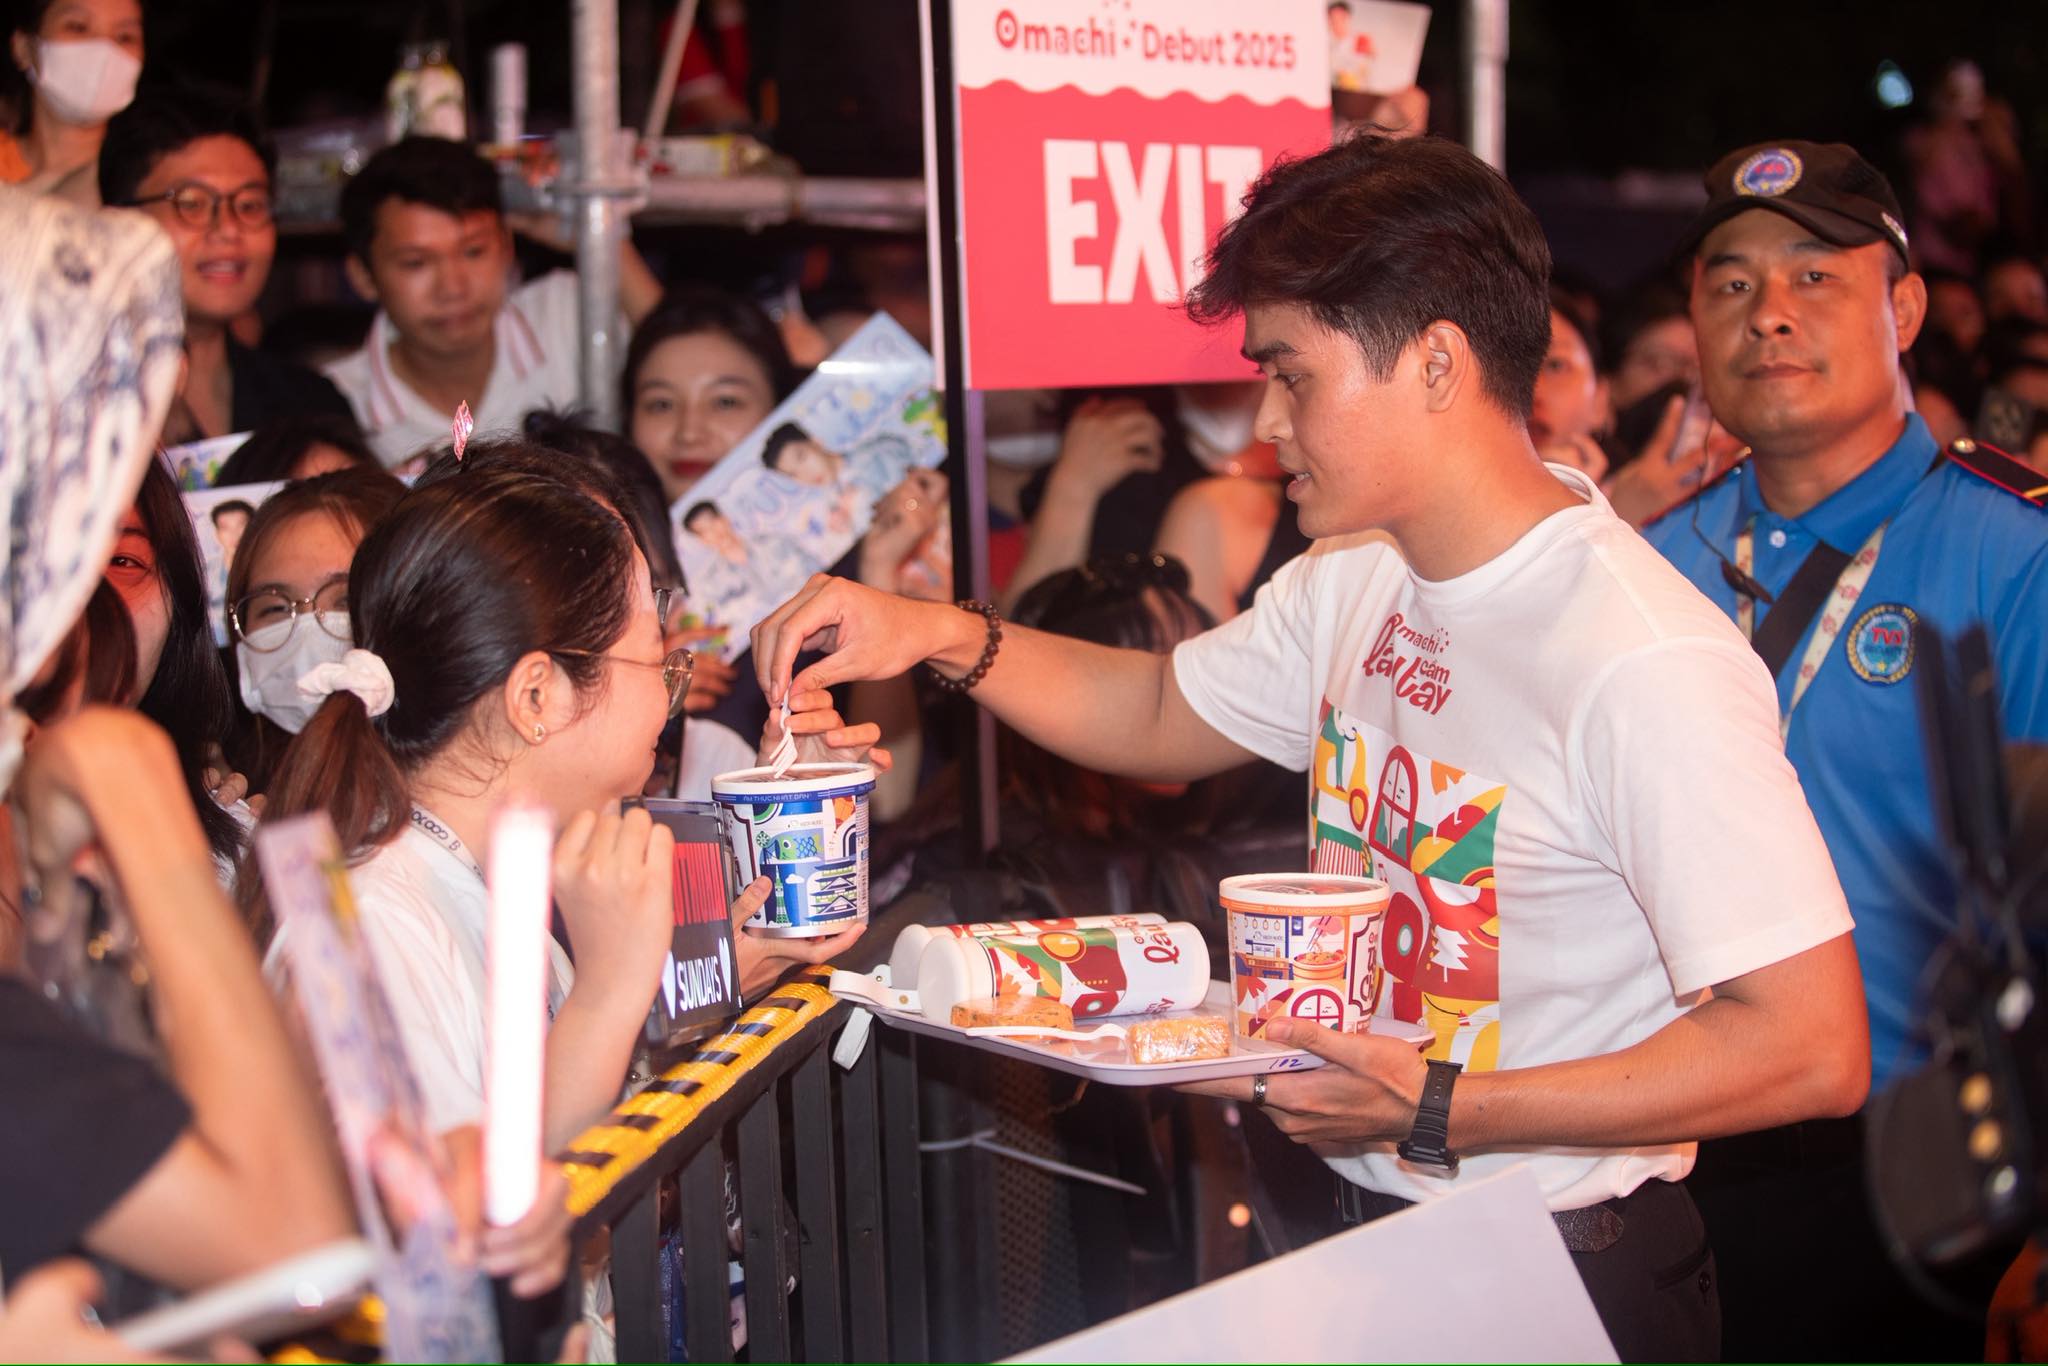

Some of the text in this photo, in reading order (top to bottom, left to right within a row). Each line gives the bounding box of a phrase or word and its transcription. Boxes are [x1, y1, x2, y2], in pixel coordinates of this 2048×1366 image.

[995, 9, 1297, 69] Omachi Debut 2025
[1042, 138, 1263, 305] EXIT
[1396, 656, 1452, 715] tay
[676, 955, 723, 1011] SUNDAYS
